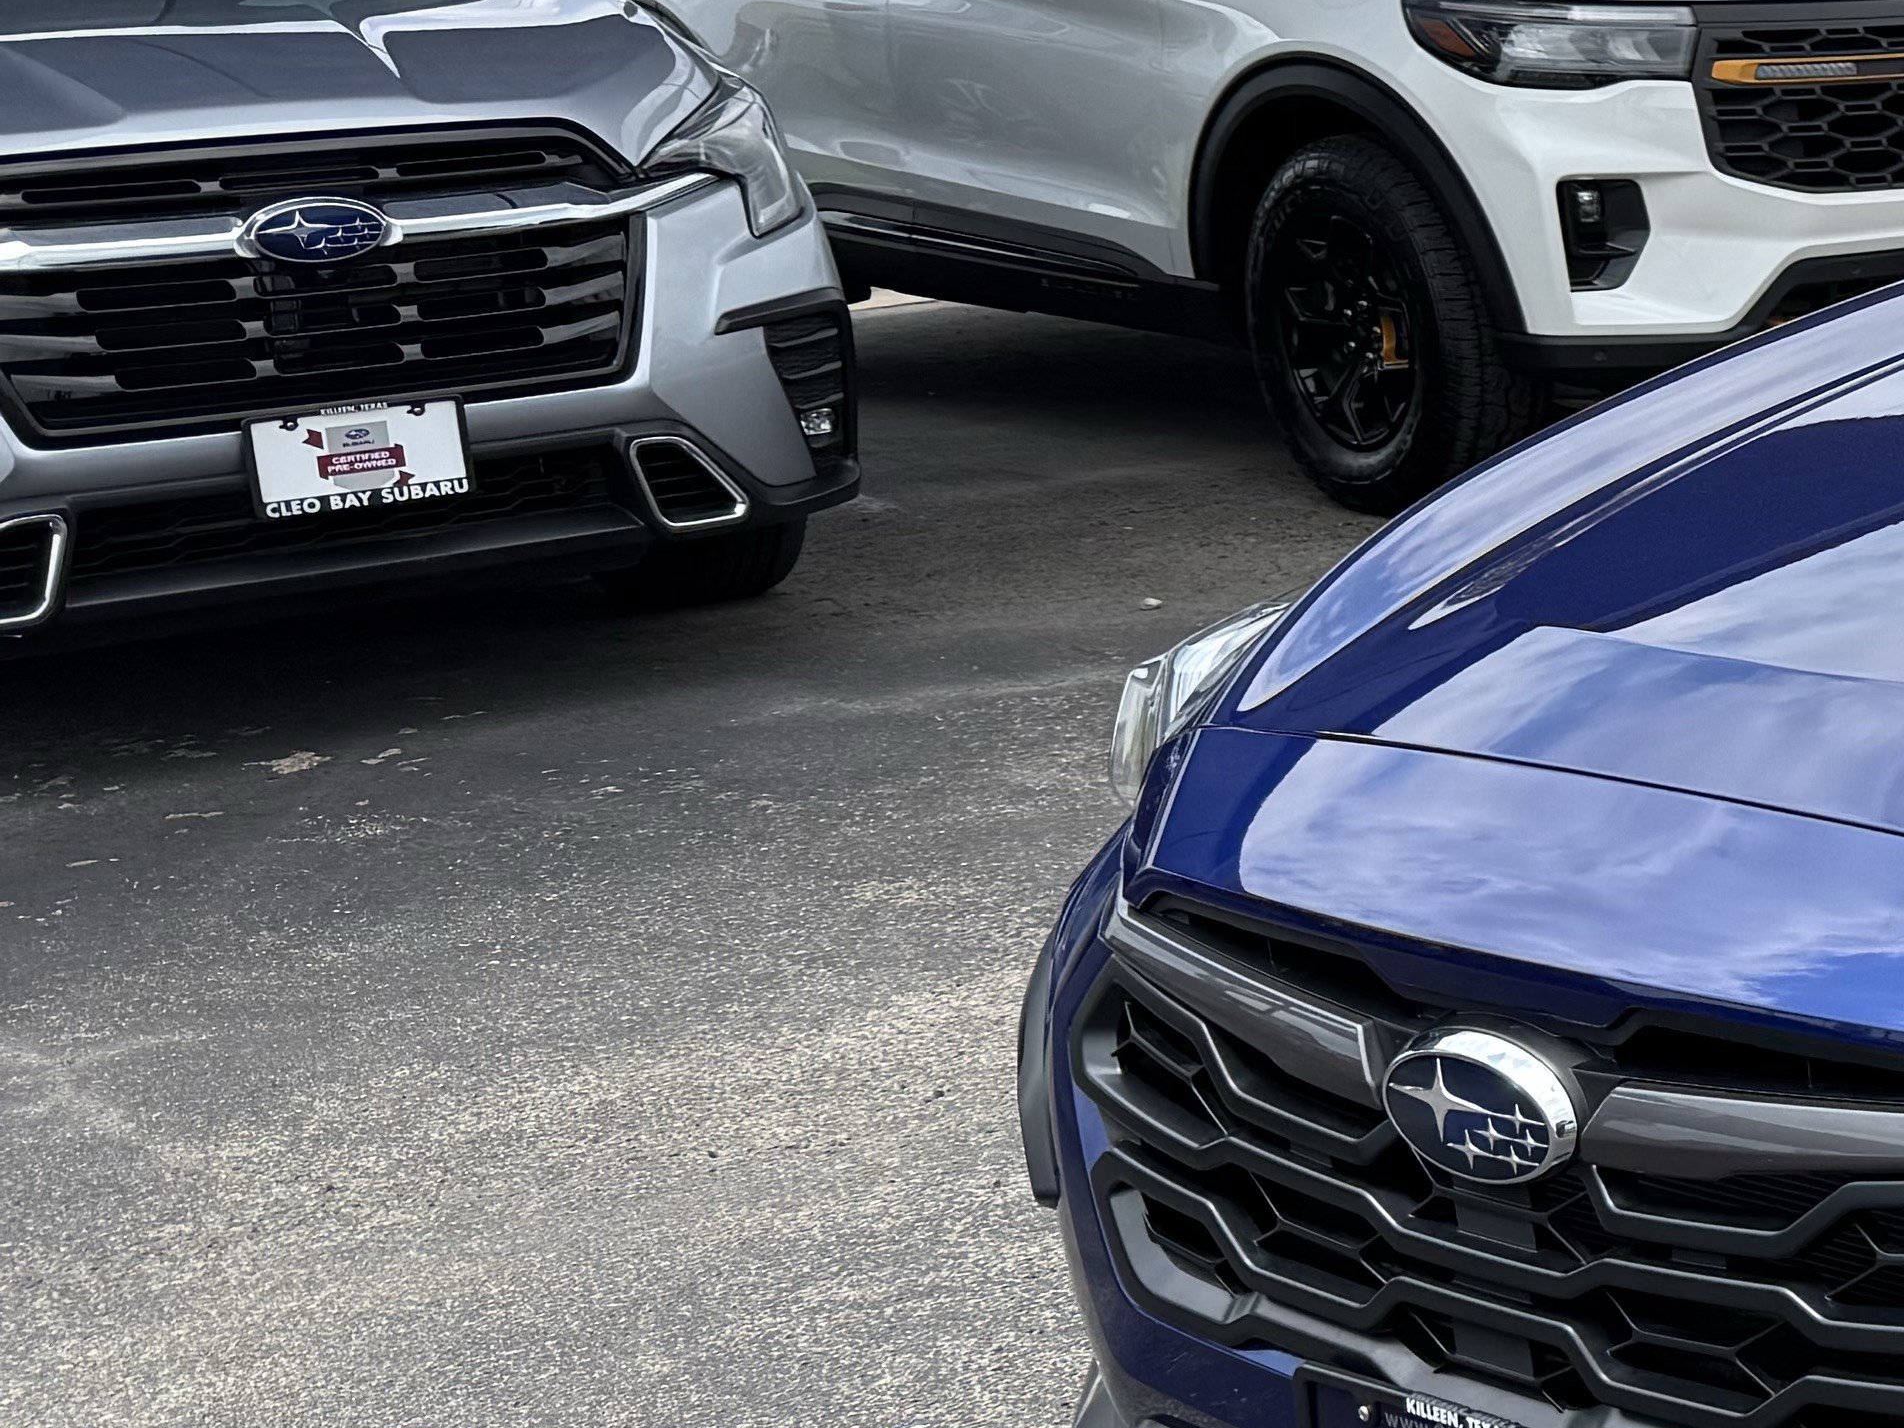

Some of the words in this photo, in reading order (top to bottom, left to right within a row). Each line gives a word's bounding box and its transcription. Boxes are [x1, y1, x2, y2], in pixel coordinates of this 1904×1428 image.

[360, 402, 389, 413] TEXAS
[332, 451, 390, 465] CERTIFIED
[327, 458, 397, 473] PRE-OWNED
[266, 498, 321, 518] CLEO
[329, 491, 372, 510] BAY
[382, 479, 469, 503] SUBARU
